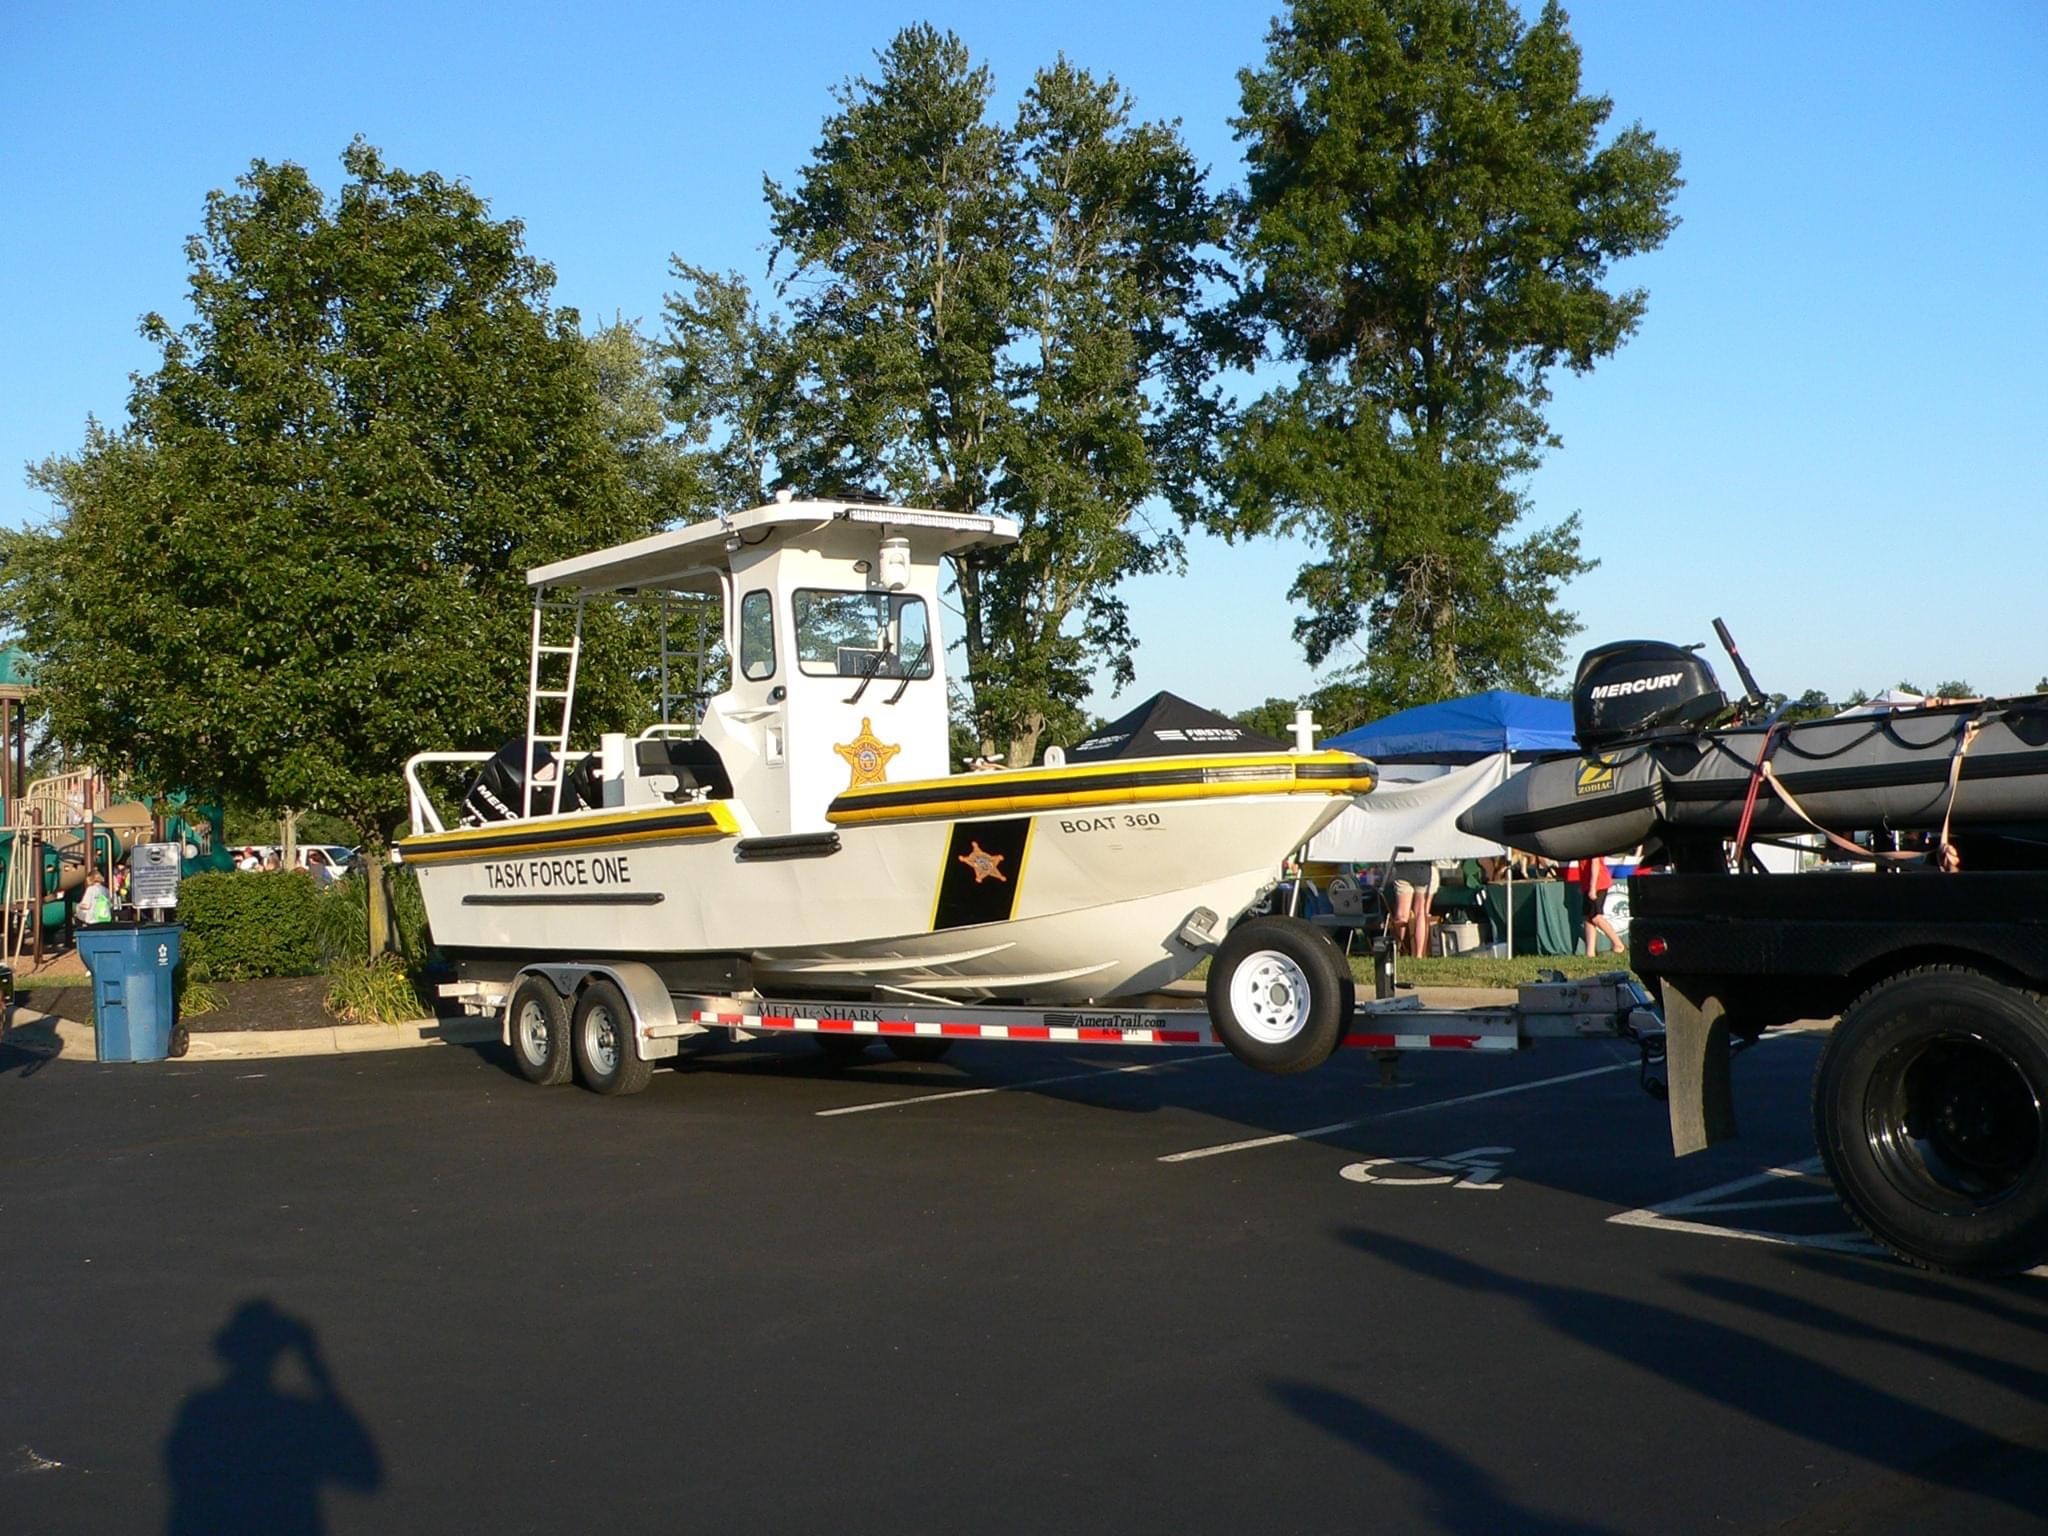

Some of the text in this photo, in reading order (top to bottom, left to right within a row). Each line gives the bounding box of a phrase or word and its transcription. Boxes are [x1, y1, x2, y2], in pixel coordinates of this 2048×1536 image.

[1590, 672, 1684, 700] MERCURY
[1577, 781, 1613, 795] ZODIAC
[1060, 812, 1160, 834] BOAT 360
[484, 856, 631, 889] TASK FORCE ONE
[757, 1003, 885, 1023] METAL SHARK
[1075, 1013, 1167, 1029] AmeraTrail.com
